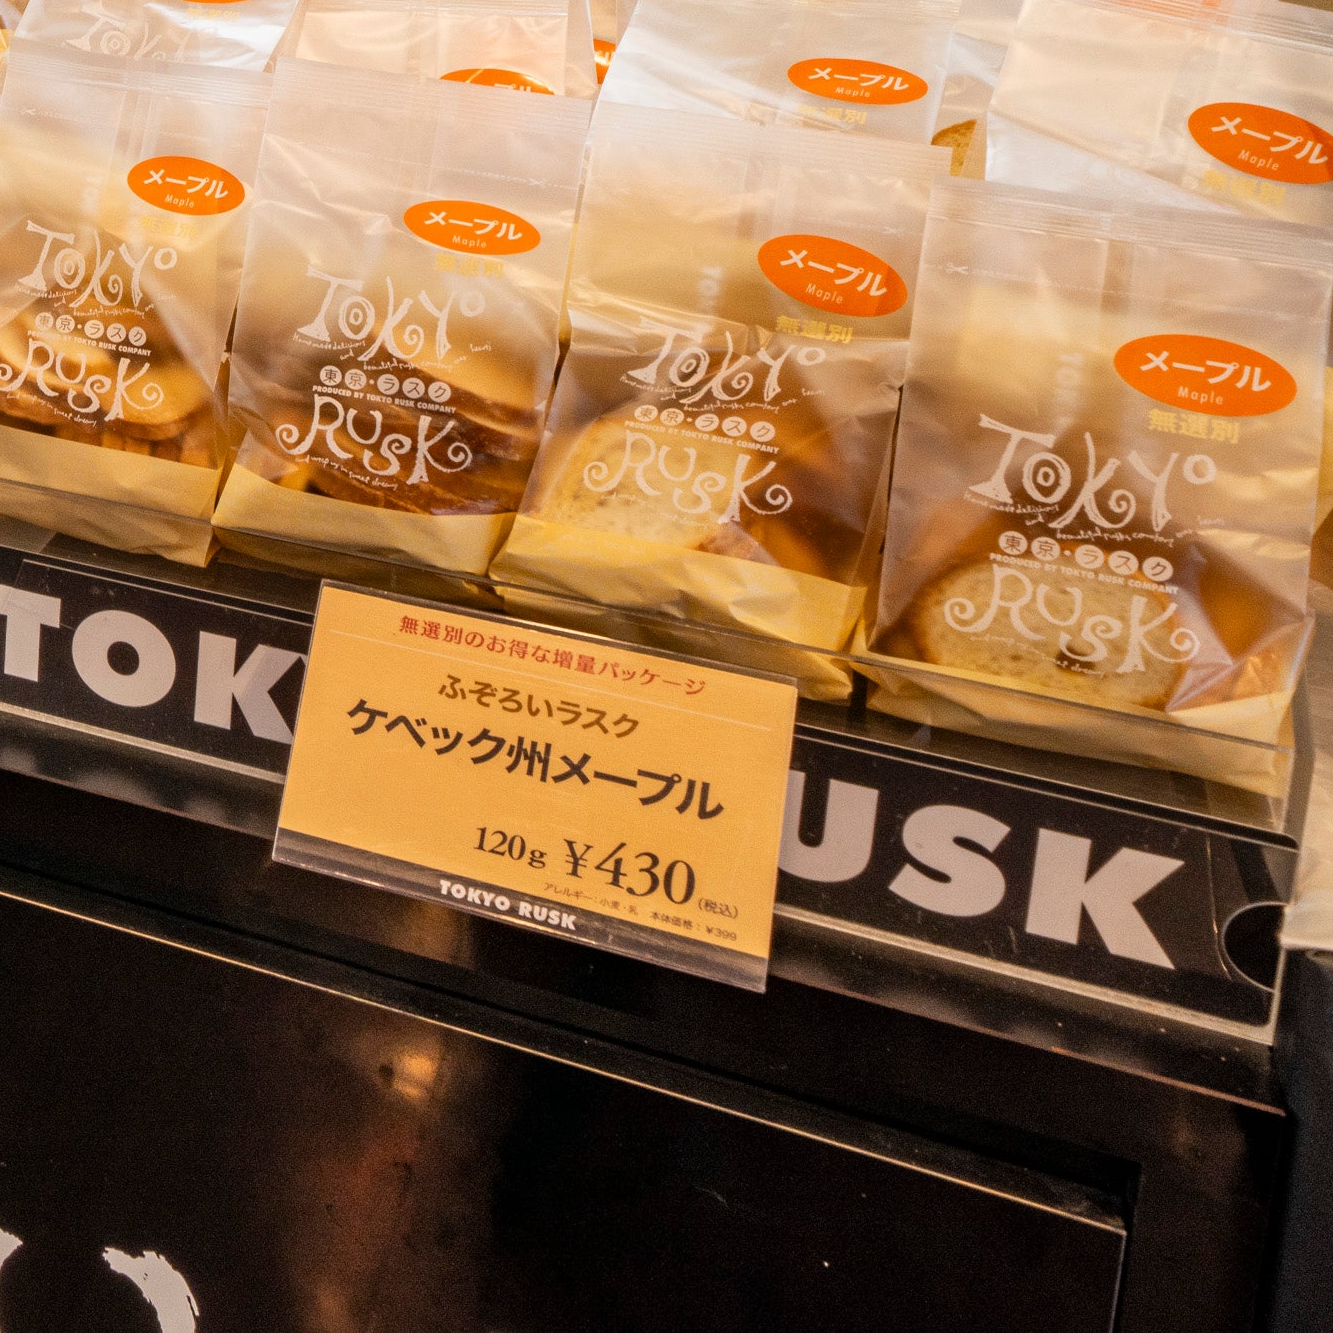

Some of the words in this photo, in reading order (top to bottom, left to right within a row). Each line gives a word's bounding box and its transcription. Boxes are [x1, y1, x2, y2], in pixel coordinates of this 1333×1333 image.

[807, 65, 910, 93] メープル
[1210, 114, 1330, 167] メープル
[143, 169, 228, 199] メープル
[423, 210, 523, 242] メープル
[18, 220, 178, 308] TOKYO
[779, 249, 887, 298] メープル
[296, 266, 485, 361] TOKYO
[319, 365, 452, 403] 東京・ラスク
[627, 315, 827, 403] TOKYO
[1139, 350, 1272, 393] メープル
[312, 385, 352, 398] PRODUCED
[354, 390, 365, 400] BY
[366, 393, 393, 405] TOKYO
[394, 397, 415, 409] RUSK
[417, 400, 456, 414] COMPANY
[634, 404, 776, 442] 東京・ラスク
[275, 394, 473, 485] RUSK
[969, 413, 1217, 531] TOKYO
[583, 429, 793, 525] RUSK
[998, 530, 1174, 582] 東京・ラスク
[943, 563, 1200, 674] RUSK
[399, 614, 707, 697] 無選別のお得な増量パッケージ
[438, 674, 640, 739] ふぞろいラスク
[346, 699, 725, 822] ケベック州メープル
[473, 826, 549, 869] 120g
[563, 838, 697, 906] ¥430
[778, 768, 1185, 971] USK
[439, 879, 512, 914] TOKYO
[518, 902, 577, 932] RUSK
